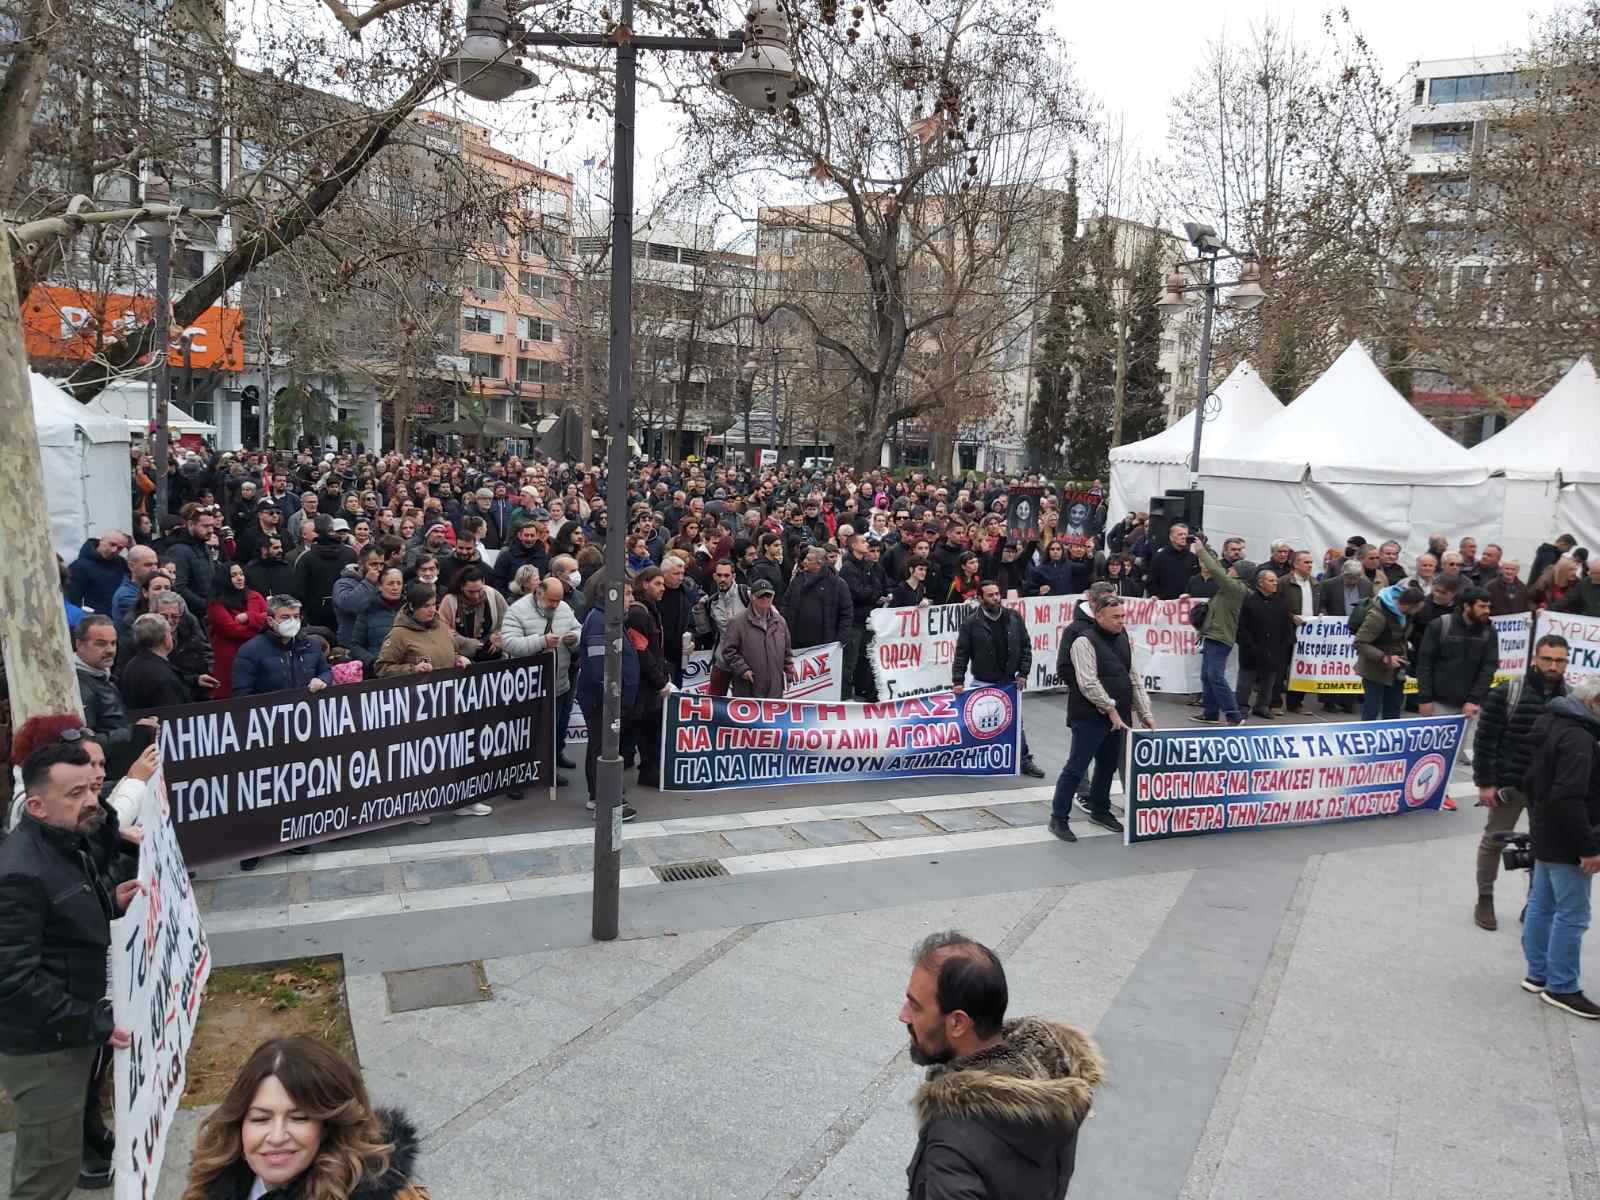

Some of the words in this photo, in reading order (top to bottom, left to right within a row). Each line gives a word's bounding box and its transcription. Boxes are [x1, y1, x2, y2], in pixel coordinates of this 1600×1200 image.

[895, 608, 920, 637] ΤΟ
[160, 711, 241, 762] ΛΗΜΑ
[245, 701, 313, 751] ΑΥΤΟ
[318, 695, 357, 739] ΜΑ
[360, 686, 410, 732] ΜΗΝ
[679, 696, 714, 722] Η
[727, 698, 847, 723] ΟΡΓΗ
[863, 692, 959, 721] ΜΑΣ
[676, 725, 712, 753] ΝΑ
[716, 726, 783, 751] ΓΙΝΕΙ
[787, 727, 879, 751] ΠΟΤΑΜΙ
[885, 722, 962, 750] ΑΓΩΝΑ
[1134, 738, 1162, 767] ΟΙ
[1165, 736, 1250, 766] ΝΕΚΡΟΙ
[1252, 734, 1300, 762] ΜΑΣ
[1302, 735, 1333, 758] ΤΑ
[1334, 728, 1407, 756] ΚΕΡΔΗ
[1407, 724, 1459, 752] ΤΟΥΣ
[171, 774, 229, 824] ΤΩΝ
[237, 754, 342, 813] ΝΕΚΡΩΝ
[349, 748, 382, 790] ΘΑ
[387, 728, 476, 782] ΓΙΝΟΥΜΕ
[480, 715, 532, 760] ΦΩΝΗ
[674, 756, 712, 783] ΓΙΑ
[714, 754, 747, 781] ΝΑ
[749, 752, 784, 779] ΜΗ
[786, 755, 884, 777] ΜΕΙΝΟΥΝ
[886, 743, 1012, 771] ΑΤΙΜΩΡΗΤΟΙ
[1137, 773, 1151, 801] Η
[1152, 771, 1193, 800] ΟΡΓΗ
[1193, 771, 1227, 797] ΜΑΣ
[1227, 769, 1249, 796] ΝΑ
[1252, 767, 1315, 793] ΤΣΑΚΙΣΕΙ
[1318, 765, 1345, 788] ΤΗΝ
[1346, 759, 1407, 786] ΠΟΛΙΤΙΚΗ
[279, 805, 350, 843] ΕΜΠΟΡΟΙ
[358, 767, 494, 825] ΑΥΤΟΑΠΑΧΟΛΟΥΜΕΝΟΙ
[494, 760, 541, 789] ΛΑΡΙΣΑΣ
[1136, 807, 1173, 836] ΠΟΥ
[1172, 804, 1225, 832] ΜΕΤΡΑ
[1227, 802, 1259, 828] ΤΗΝ
[1260, 801, 1292, 825] ΖΩΗ
[1294, 799, 1324, 822] ΜΑΣ
[1325, 797, 1346, 818] ΩΣ
[1347, 789, 1402, 817] ΚΟΣΤΟΣ
